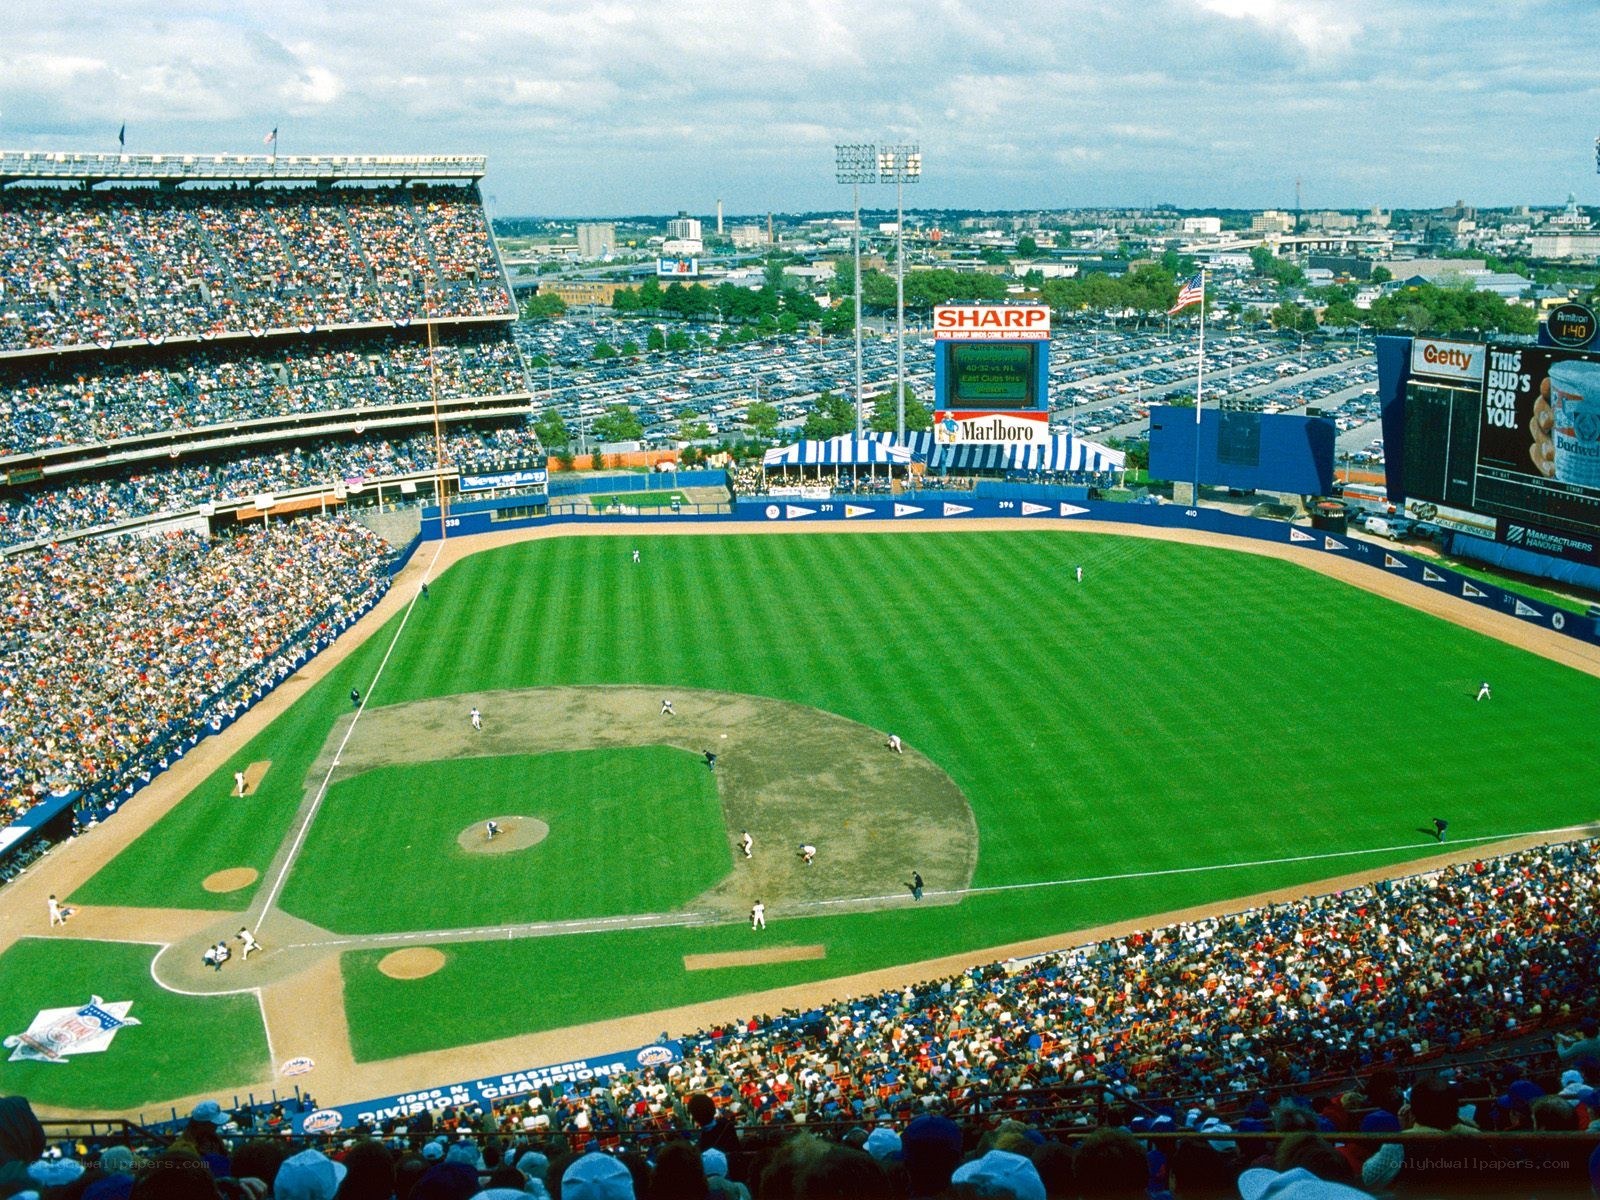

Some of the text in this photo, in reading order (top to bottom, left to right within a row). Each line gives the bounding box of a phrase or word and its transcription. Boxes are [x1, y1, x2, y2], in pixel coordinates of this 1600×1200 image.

[938, 310, 1046, 327] SHARP
[953, 331, 970, 339] SHARP
[1003, 331, 1020, 339] SHARP
[1020, 331, 1048, 339] PRODUCTS
[1563, 324, 1586, 338] 1:40
[1424, 344, 1473, 371] Getty
[1490, 351, 1522, 372] THIS
[1488, 370, 1531, 393] BUD'S
[1486, 388, 1516, 410] FOR
[1486, 406, 1519, 430] YOU.
[962, 419, 1034, 441] Marlboro
[463, 471, 546, 487] Newsday
[820, 504, 834, 512] 371
[999, 501, 1014, 509] 396
[1184, 508, 1198, 518] 410
[445, 518, 460, 528] 338
[1435, 518, 1493, 538] QUALITY SNACKS
[1525, 528, 1593, 552] MANUFACTURERS
[1525, 538, 1564, 553] HANOVER
[1503, 594, 1515, 605] 371
[396, 1061, 587, 1105] 1986 N. L. EASTERN
[357, 1062, 627, 1123] DIVISION CHAMPIONS
